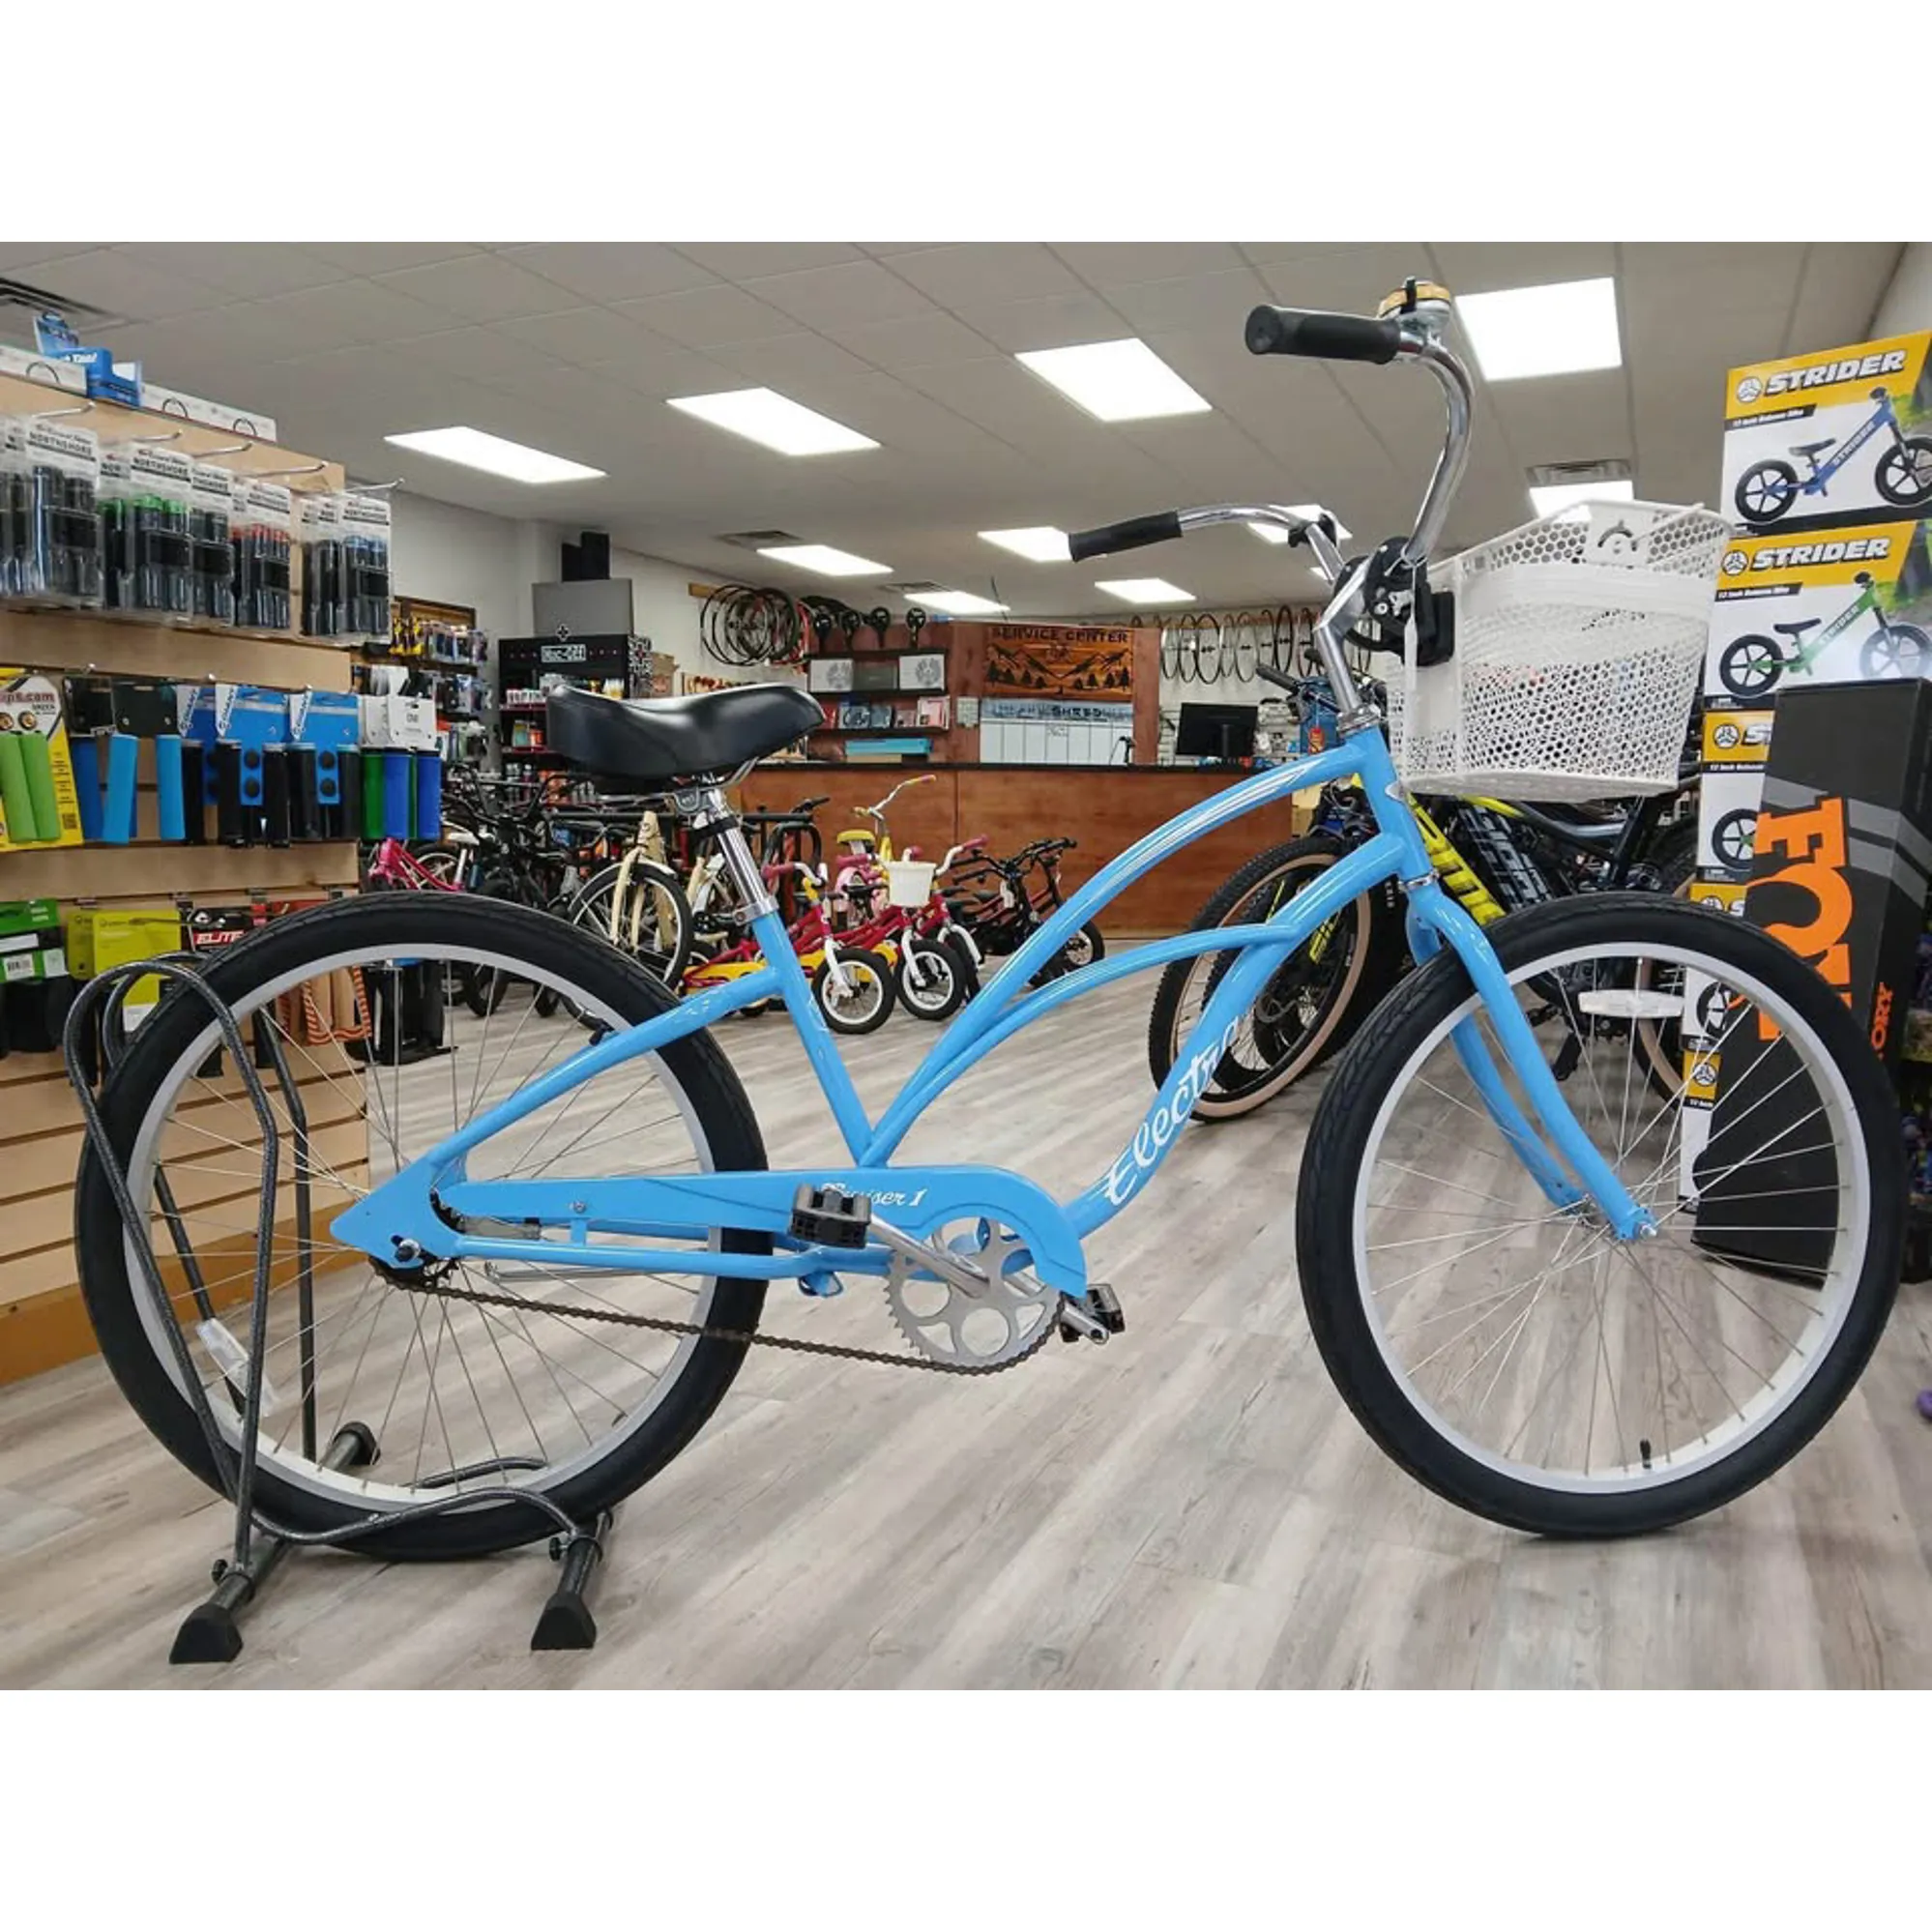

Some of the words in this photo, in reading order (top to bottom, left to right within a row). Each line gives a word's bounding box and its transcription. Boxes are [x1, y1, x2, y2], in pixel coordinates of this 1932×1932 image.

[1765, 350, 1906, 395] STRIDER
[1750, 538, 1891, 571] STRIDER
[993, 627, 1059, 641] SERVICE
[1066, 629, 1128, 643] CENTER
[1089, 1015, 1239, 1206] Electra
[908, 1188, 928, 1207] 1
